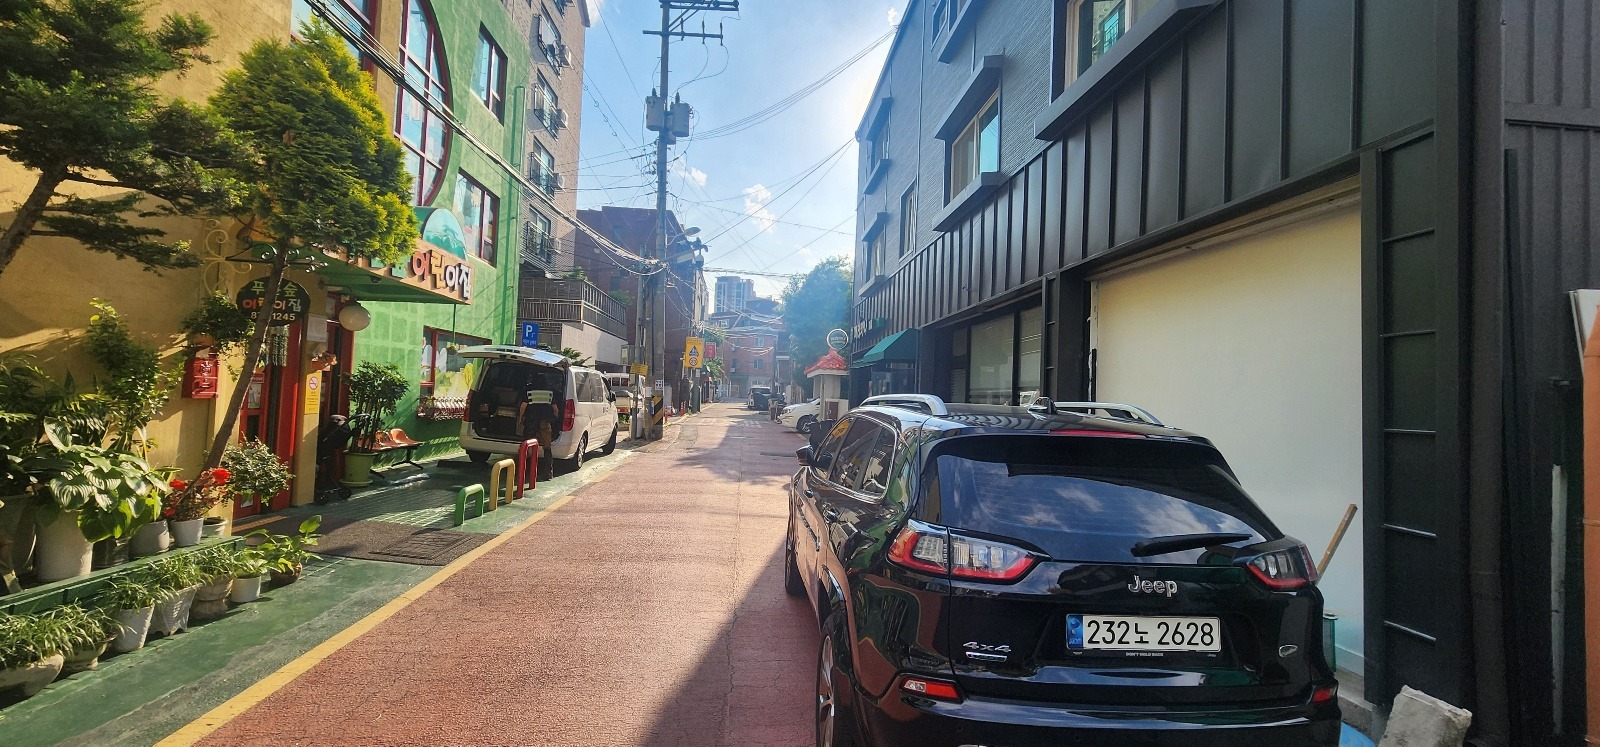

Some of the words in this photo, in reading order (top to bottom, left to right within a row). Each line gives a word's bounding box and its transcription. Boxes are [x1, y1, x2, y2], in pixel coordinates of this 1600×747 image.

[412, 249, 472, 300] 어린이집
[251, 280, 298, 298] 푸숲
[525, 324, 533, 338] P
[1127, 574, 1178, 598] Jeep
[1087, 619, 1149, 645] 232노
[1157, 621, 1214, 646] 2628
